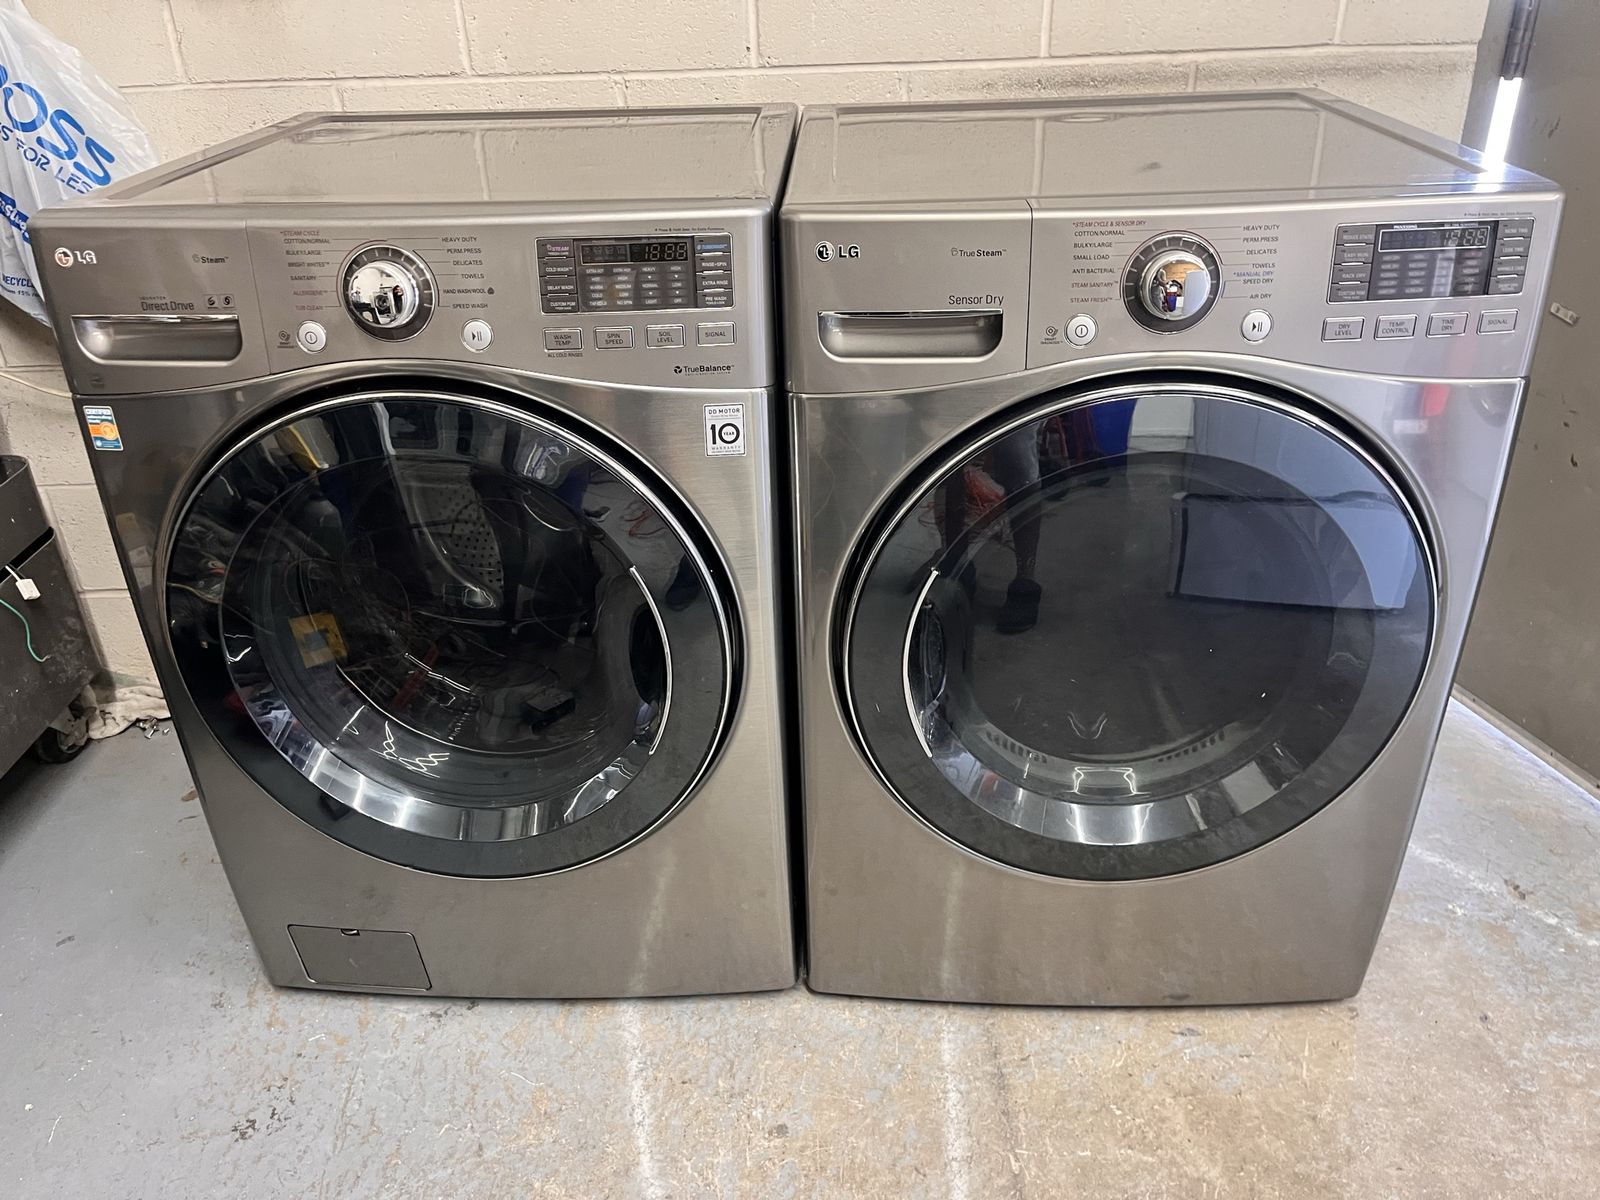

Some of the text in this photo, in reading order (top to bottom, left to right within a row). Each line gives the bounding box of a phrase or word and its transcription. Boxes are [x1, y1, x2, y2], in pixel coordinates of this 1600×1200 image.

[16, 137, 50, 171] FOR
[74, 250, 98, 265] LG
[838, 244, 861, 260] LG
[948, 292, 1005, 306] Sensor Dry
[710, 422, 740, 445] 10
